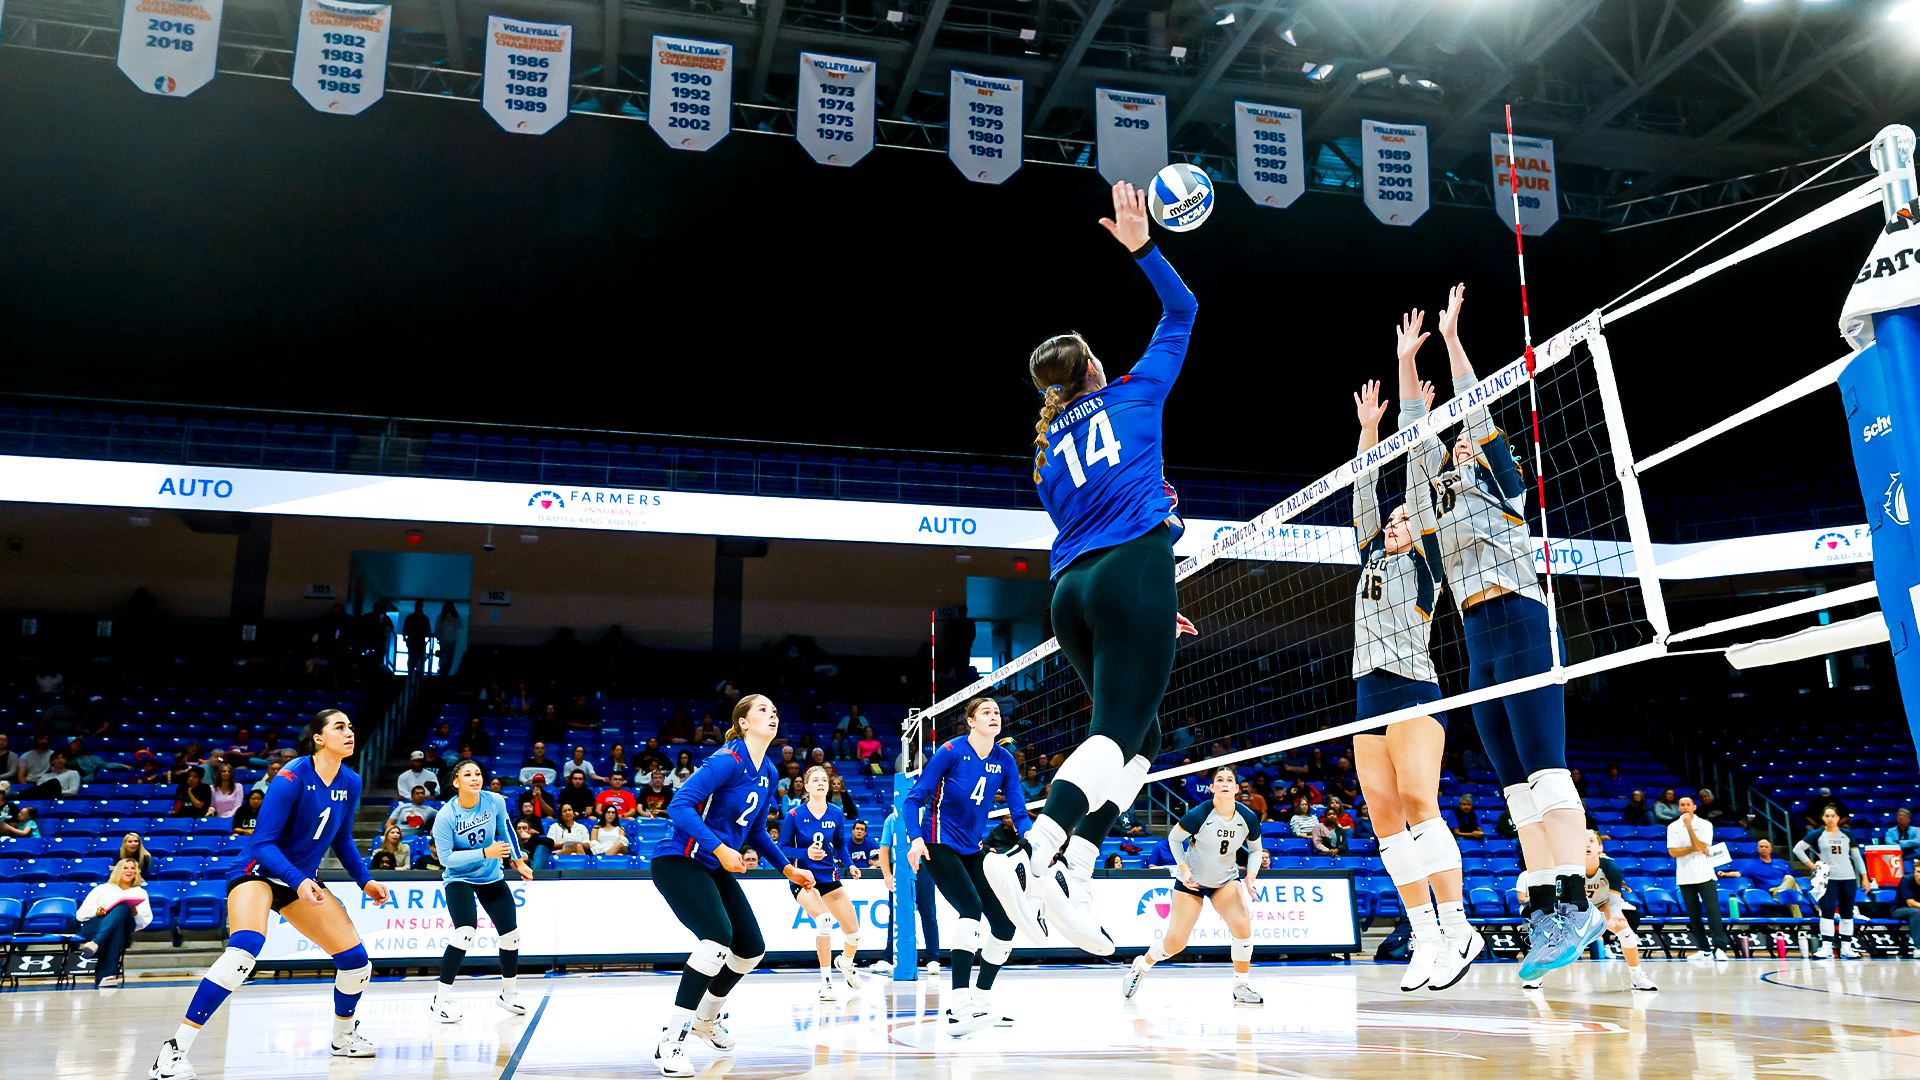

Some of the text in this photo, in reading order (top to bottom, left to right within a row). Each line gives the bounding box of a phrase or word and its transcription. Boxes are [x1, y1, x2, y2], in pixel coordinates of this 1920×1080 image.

[135, 4, 212, 22] CHAMPIONS
[318, 2, 378, 16] VOLLEYBALL
[308, 9, 384, 27] CONFERENCE
[310, 17, 381, 33] CHAMPIONS
[147, 18, 195, 36] 2016
[503, 23, 559, 37] VOLLEYBALL
[145, 35, 194, 52] 2018
[323, 32, 366, 48] 1982
[494, 32, 565, 47] CONFERENCE
[495, 38, 563, 53] CHAMPIONS
[321, 49, 365, 64] 1983
[666, 43, 720, 56] VOLLEYBALL
[507, 54, 549, 68] 1986
[658, 50, 726, 66] CONFERENCE
[660, 57, 724, 72] CHAMPIONS
[318, 64, 363, 80] 1984
[813, 59, 864, 73] VOLLEYBALL
[507, 68, 548, 83] 1987
[670, 72, 712, 86] 1990
[828, 72, 846, 80] NIT
[317, 79, 361, 95] 1985
[506, 83, 548, 98] 1988
[819, 83, 855, 97] 1973
[963, 77, 1012, 91] VOLLEYBALL
[671, 86, 710, 101] 1992
[977, 88, 995, 97] NIT
[1108, 93, 1156, 105] VOLLEYBALL
[504, 98, 547, 113] 1989
[669, 101, 711, 116] 1998
[818, 97, 855, 112] 1974
[968, 101, 1004, 116] 1978
[1123, 103, 1139, 111] NIT
[817, 112, 853, 127] 1975
[1246, 107, 1293, 119] VOLLEYBALL
[668, 116, 711, 131] 2002
[968, 115, 1003, 130] 1979
[1114, 116, 1149, 130] 2019
[1255, 116, 1281, 126] NCAA
[816, 127, 854, 142] 1976
[967, 129, 1004, 144] 1980
[1253, 129, 1286, 143] 1985
[1373, 125, 1417, 136] VOLLEYBALL
[1380, 135, 1406, 144] NCAA
[968, 144, 1003, 159] 1981
[1253, 143, 1287, 157] 1986
[1377, 149, 1411, 161] 1989
[1254, 157, 1287, 170] 1987
[1377, 162, 1412, 175] 1990
[1494, 154, 1553, 173] FINAL
[1253, 170, 1288, 184] 1988
[1378, 176, 1412, 188] 2001
[1498, 173, 1550, 192] FOUR
[1378, 189, 1413, 202] 2002
[1169, 191, 1204, 217] molten
[1178, 202, 1206, 226] NCAA
[1449, 398, 1463, 417] UT
[1050, 396, 1104, 435] MAVERICKS
[1053, 409, 1122, 488] 14
[1351, 424, 1420, 474] UT ARLINGTON
[158, 477, 233, 498] AUTO
[571, 491, 661, 506] FARMERS
[1274, 478, 1330, 519] UT ARLINGTON
[584, 507, 646, 516] INSURANCE
[538, 515, 647, 527] DAMITA KING AGENCY
[918, 517, 977, 535] AUTO
[1268, 528, 1321, 539] RMERS
[1535, 548, 1583, 565] AUTO
[1826, 552, 1863, 561] DAMITA
[312, 585, 330, 594] 101
[1362, 573, 1383, 601] 16
[488, 591, 505, 600] 102
[938, 608, 953, 617] 102
[985, 762, 1002, 773] UTA
[331, 790, 348, 801] UTA
[970, 776, 987, 805] 4
[735, 791, 759, 826] 2
[313, 807, 331, 839] 1
[455, 810, 492, 831] Mavericks
[821, 821, 836, 829] UTA
[468, 828, 486, 847] 83
[813, 832, 824, 849] 8
[1217, 829, 1235, 838] CBU
[1220, 840, 1229, 855] 8
[1831, 845, 1842, 854] 21
[1890, 856, 1901, 868] G
[361, 889, 526, 909] FARMS
[1252, 886, 1324, 903] MERS
[792, 899, 890, 930] ATO
[1254, 927, 1310, 939] AGENCY
[375, 937, 418, 950] KING
